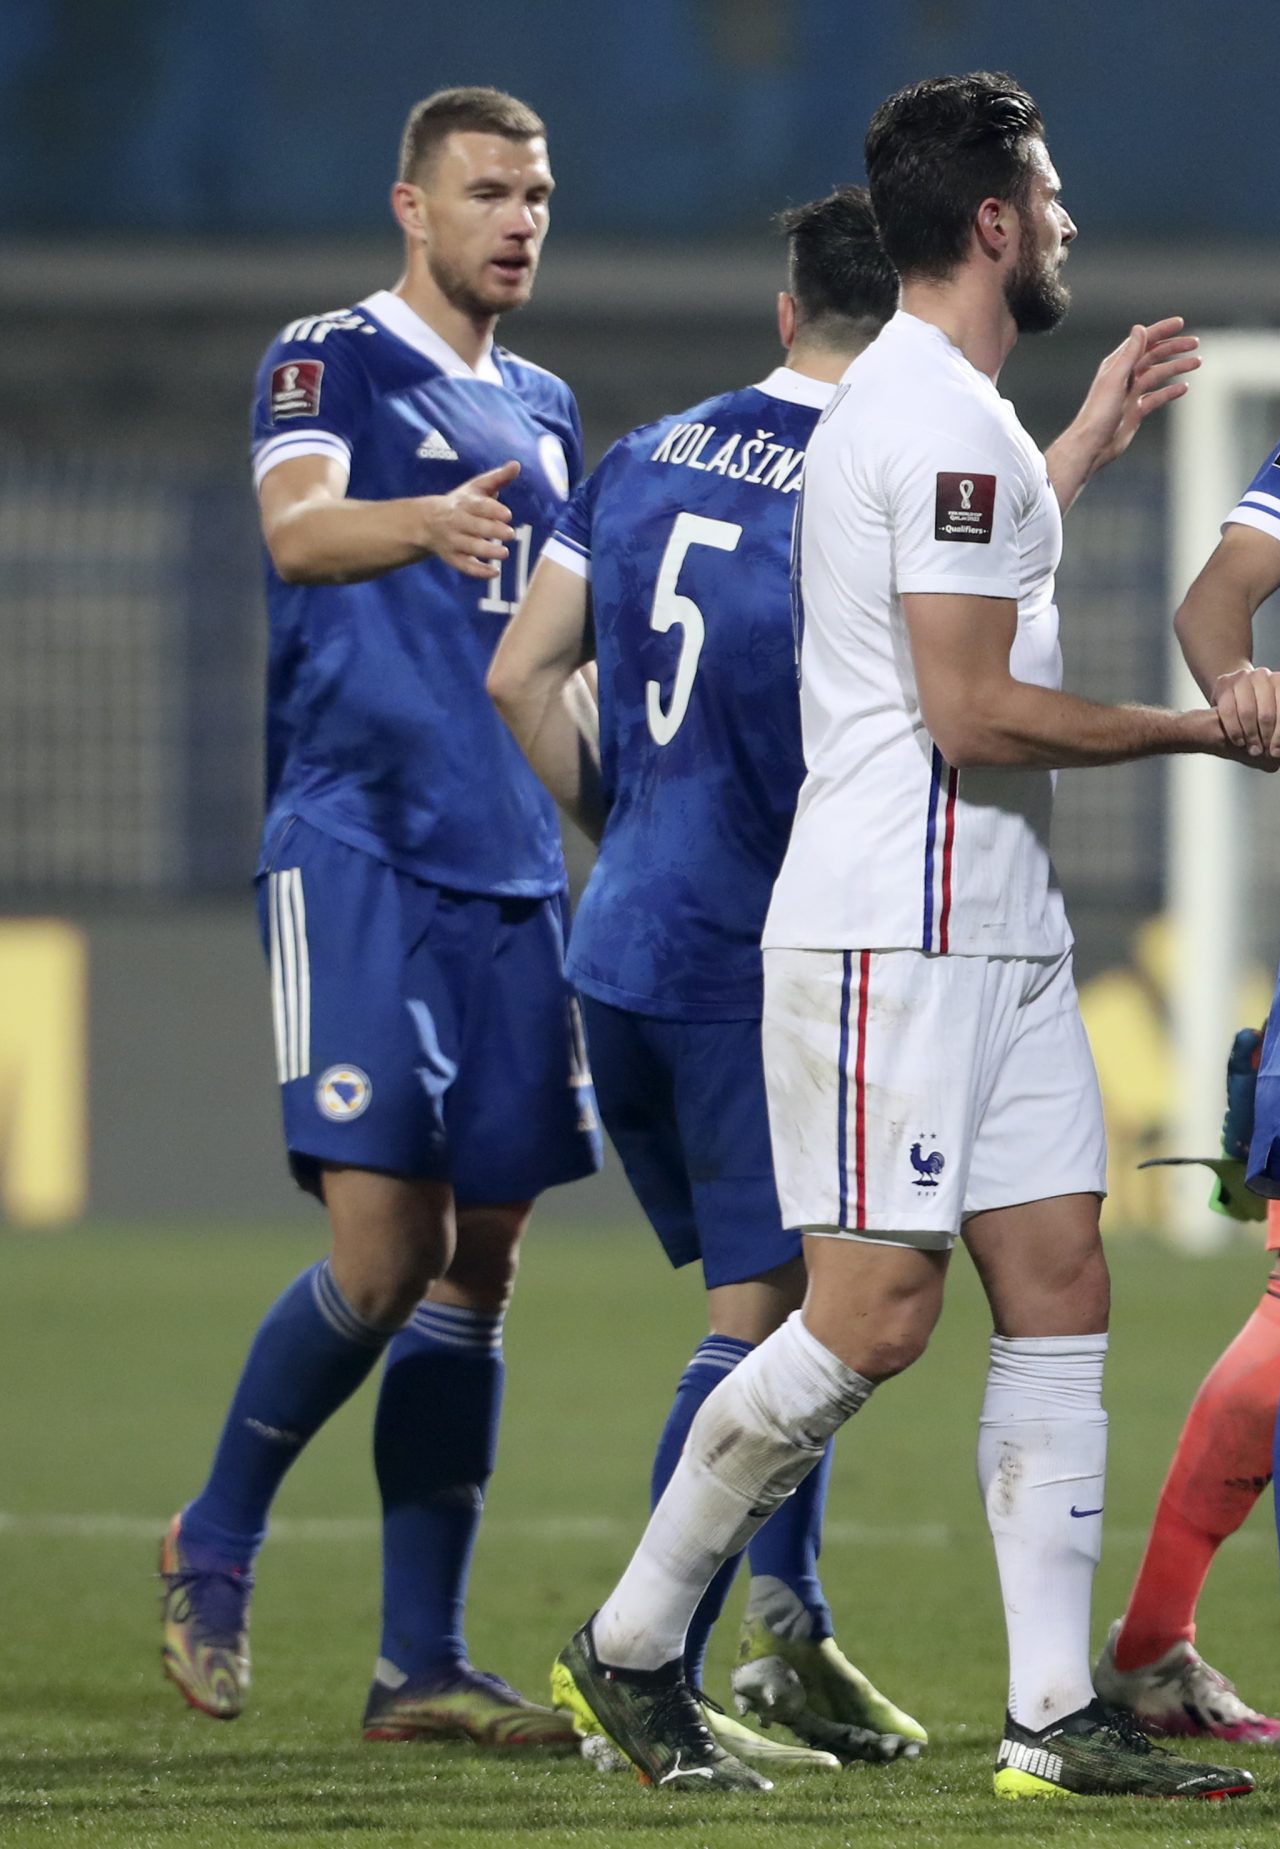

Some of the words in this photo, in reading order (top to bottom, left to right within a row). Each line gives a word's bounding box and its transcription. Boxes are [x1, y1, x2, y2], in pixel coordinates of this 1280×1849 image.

[945, 524, 983, 534] Qualifiers
[645, 511, 742, 747] 5
[997, 1739, 1063, 1782] PUMA
